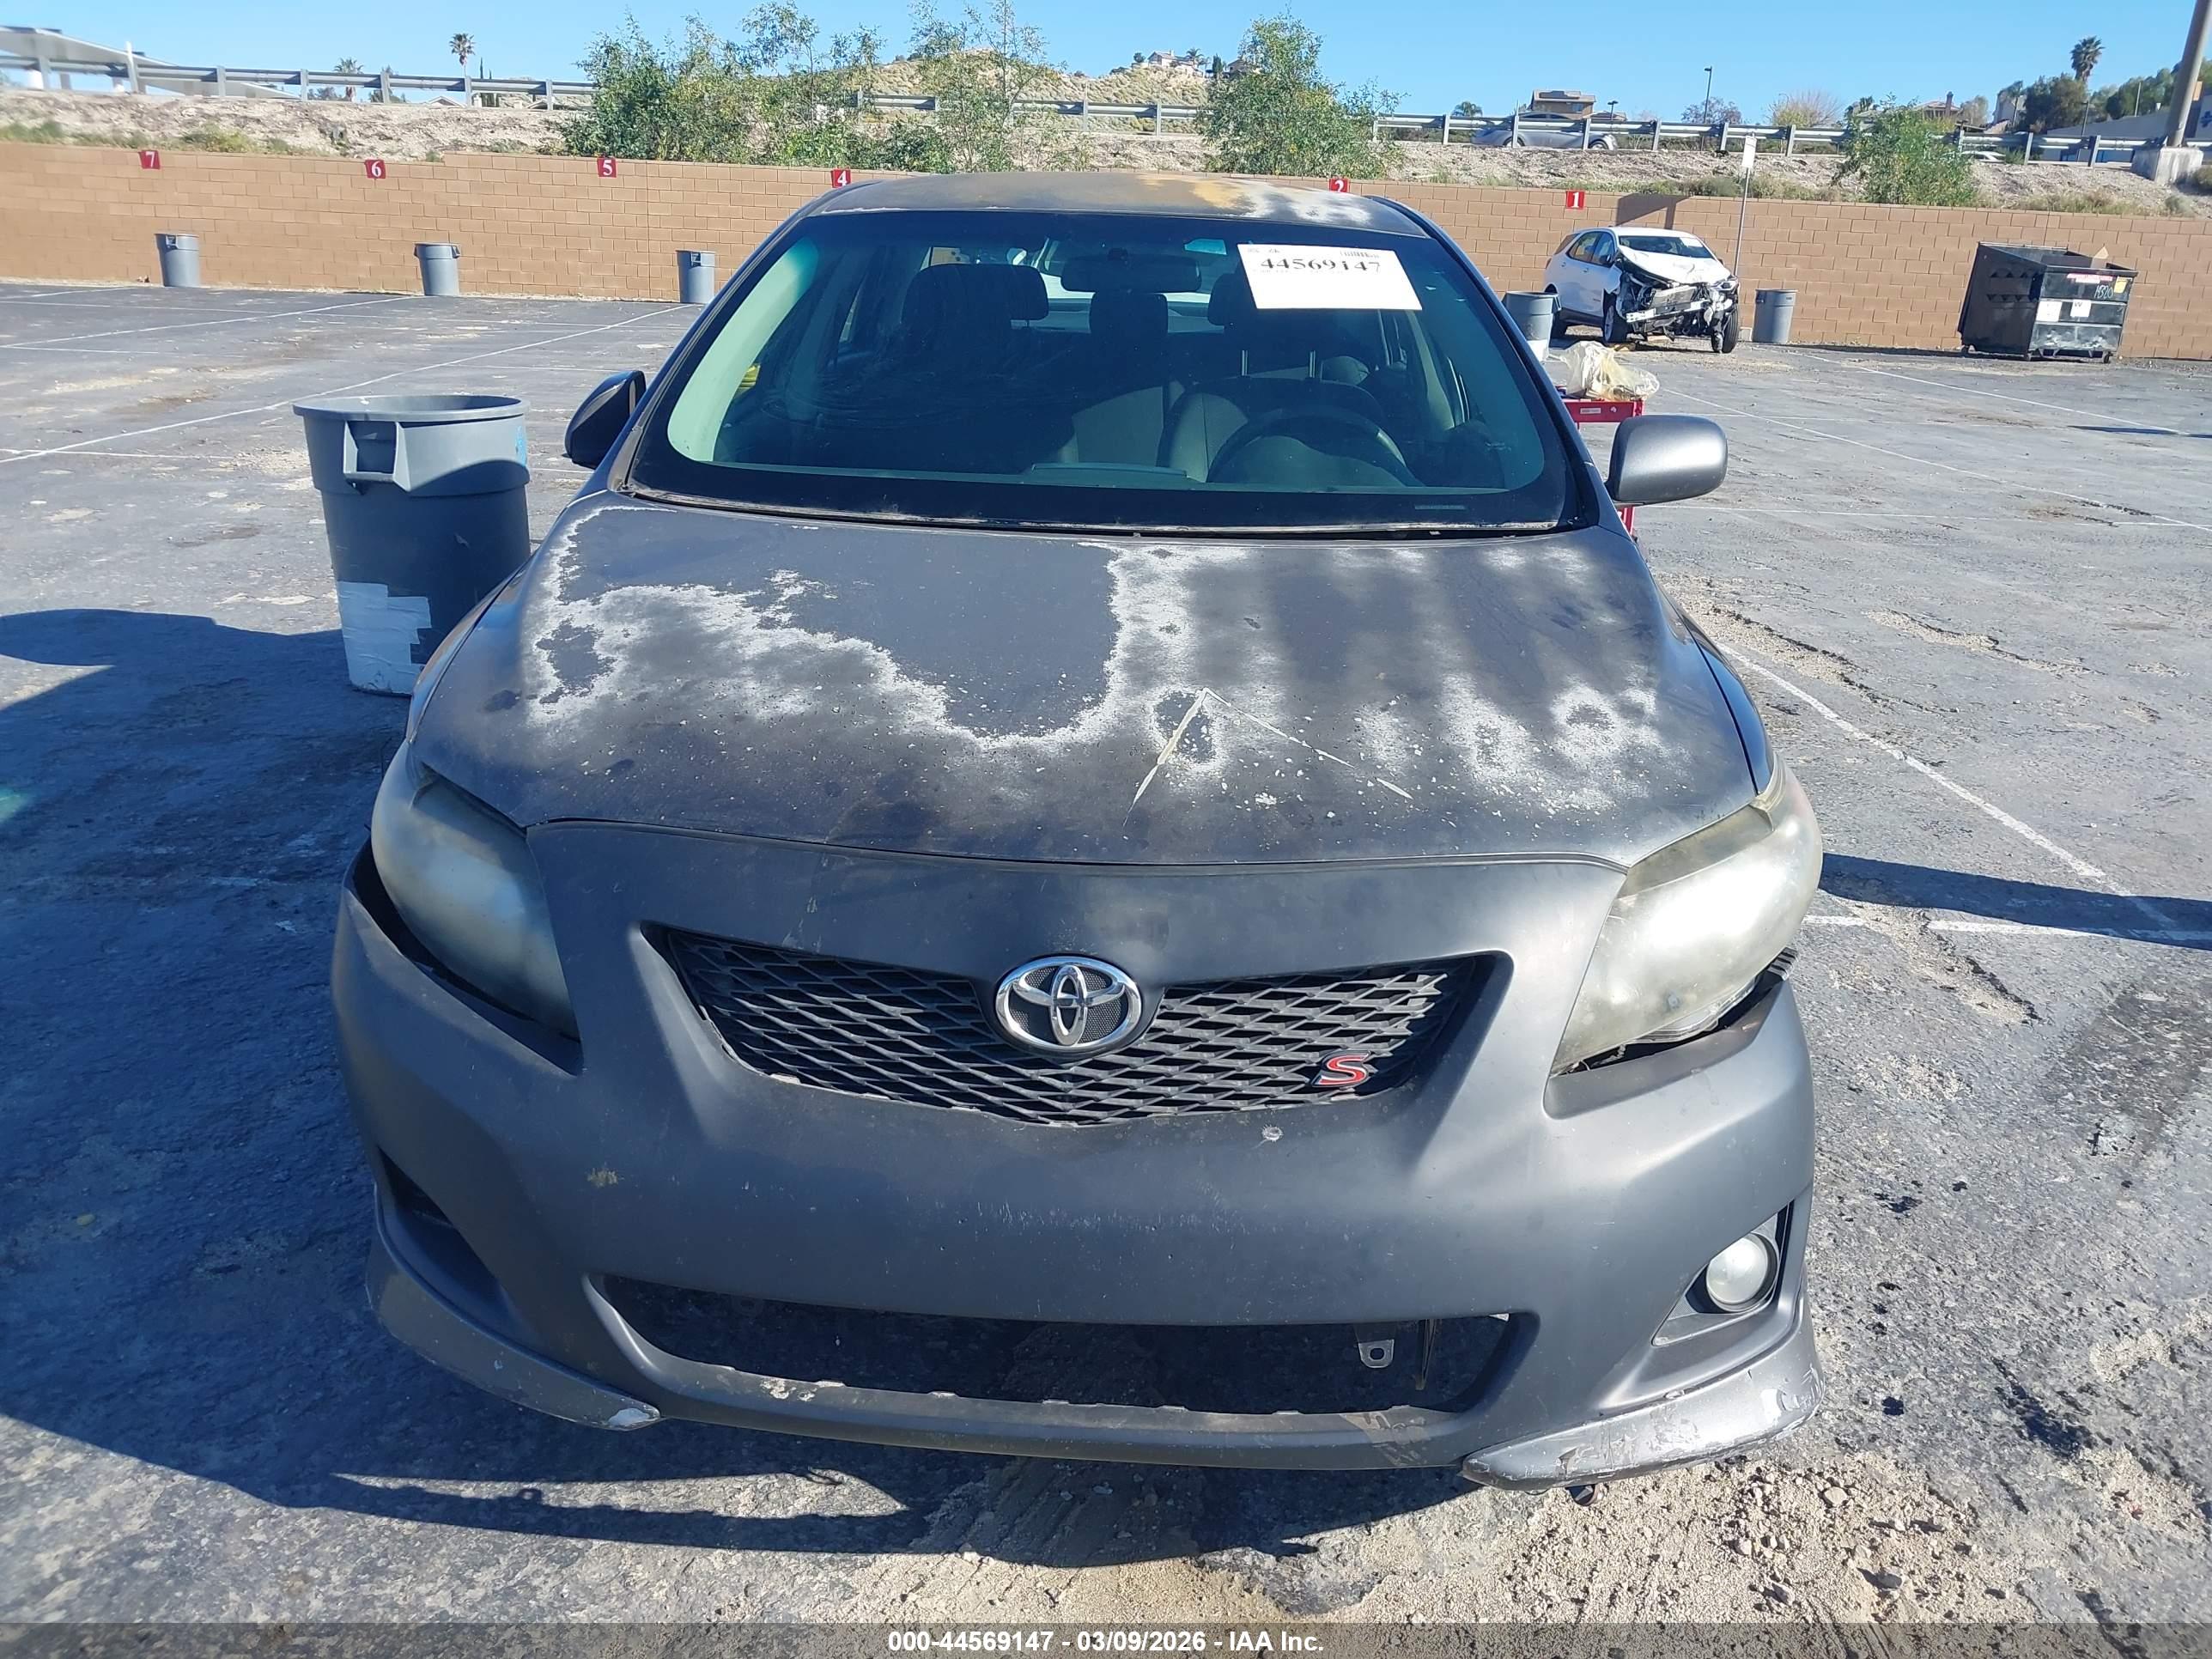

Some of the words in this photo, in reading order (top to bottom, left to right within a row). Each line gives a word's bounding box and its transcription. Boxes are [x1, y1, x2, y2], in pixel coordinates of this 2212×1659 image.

[146, 151, 155, 167] 7
[372, 161, 382, 177] 6
[603, 160, 612, 175] 5
[837, 172, 847, 186] 4
[1334, 180, 1345, 192] 2
[1572, 191, 1580, 208] 1
[1261, 258, 1380, 272] 44569147
[1315, 1052, 1371, 1086] S
